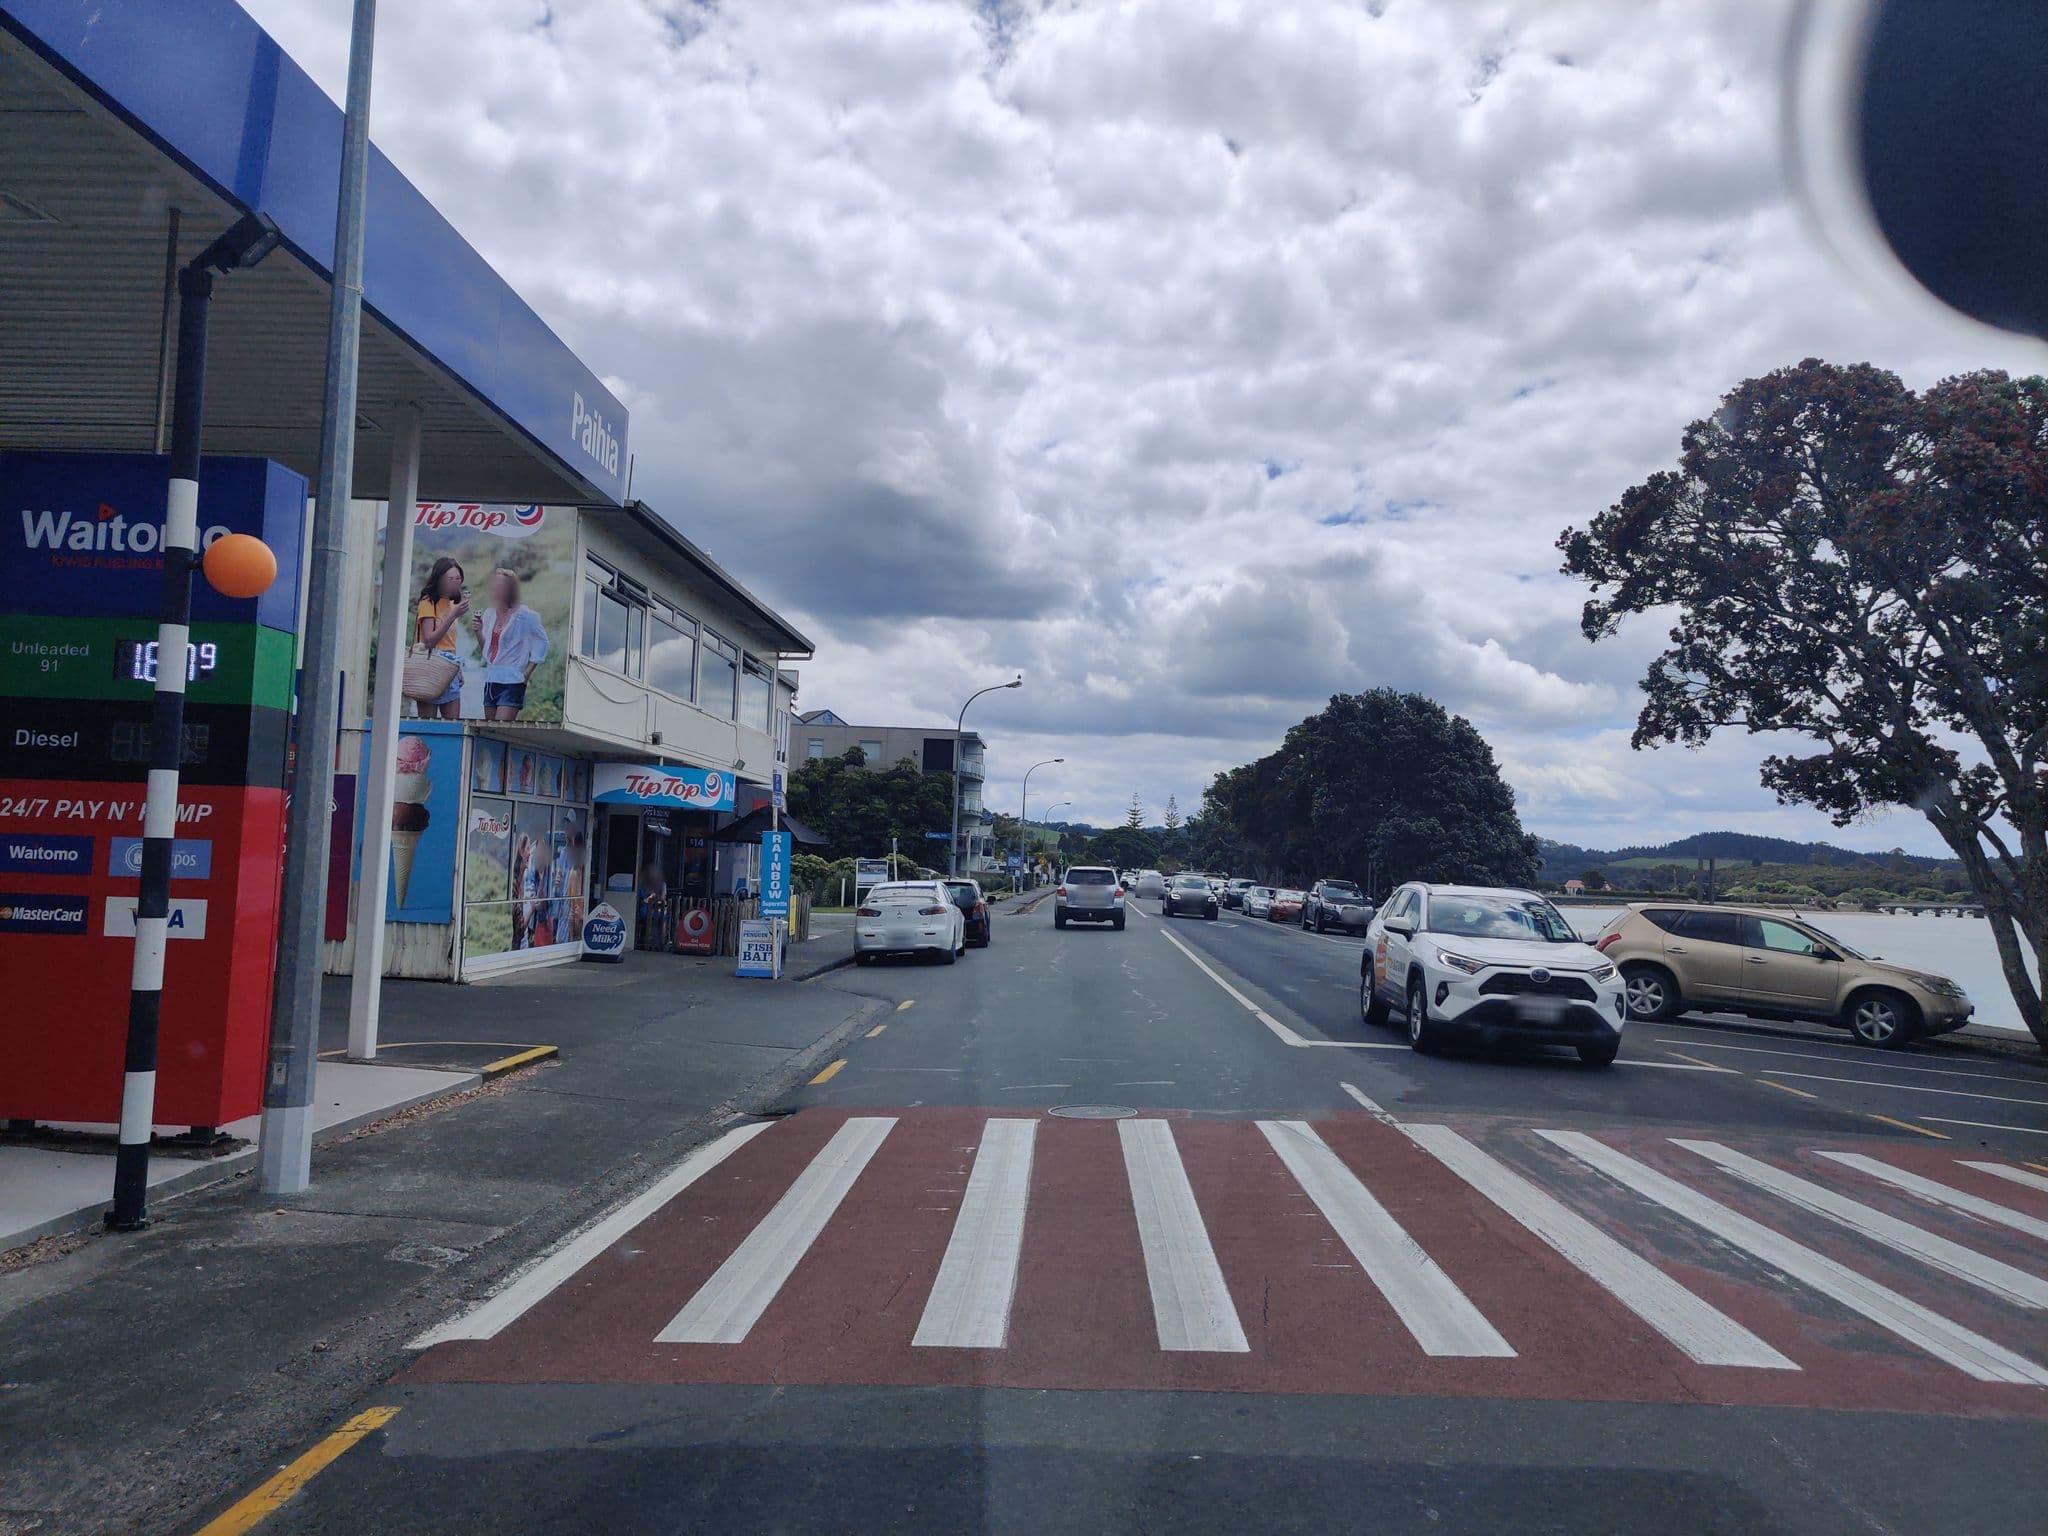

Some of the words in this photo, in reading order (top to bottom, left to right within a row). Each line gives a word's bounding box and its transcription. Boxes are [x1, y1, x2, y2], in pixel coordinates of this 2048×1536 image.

[571, 391, 619, 477] Paihia
[415, 503, 455, 529] Tip
[458, 504, 506, 530] Top
[12, 642, 89, 657] Unleaded
[41, 659, 60, 672] 91
[15, 729, 78, 748] Diesel
[626, 774, 662, 798] Tip
[663, 777, 700, 799] Top
[0, 798, 49, 818] 24/7
[53, 799, 104, 820] PAY
[9, 843, 78, 862] Waitomo
[768, 834, 782, 899] RAINBOW
[12, 907, 83, 923] MasterCard
[592, 923, 617, 934] Need
[591, 933, 618, 944] Milk?
